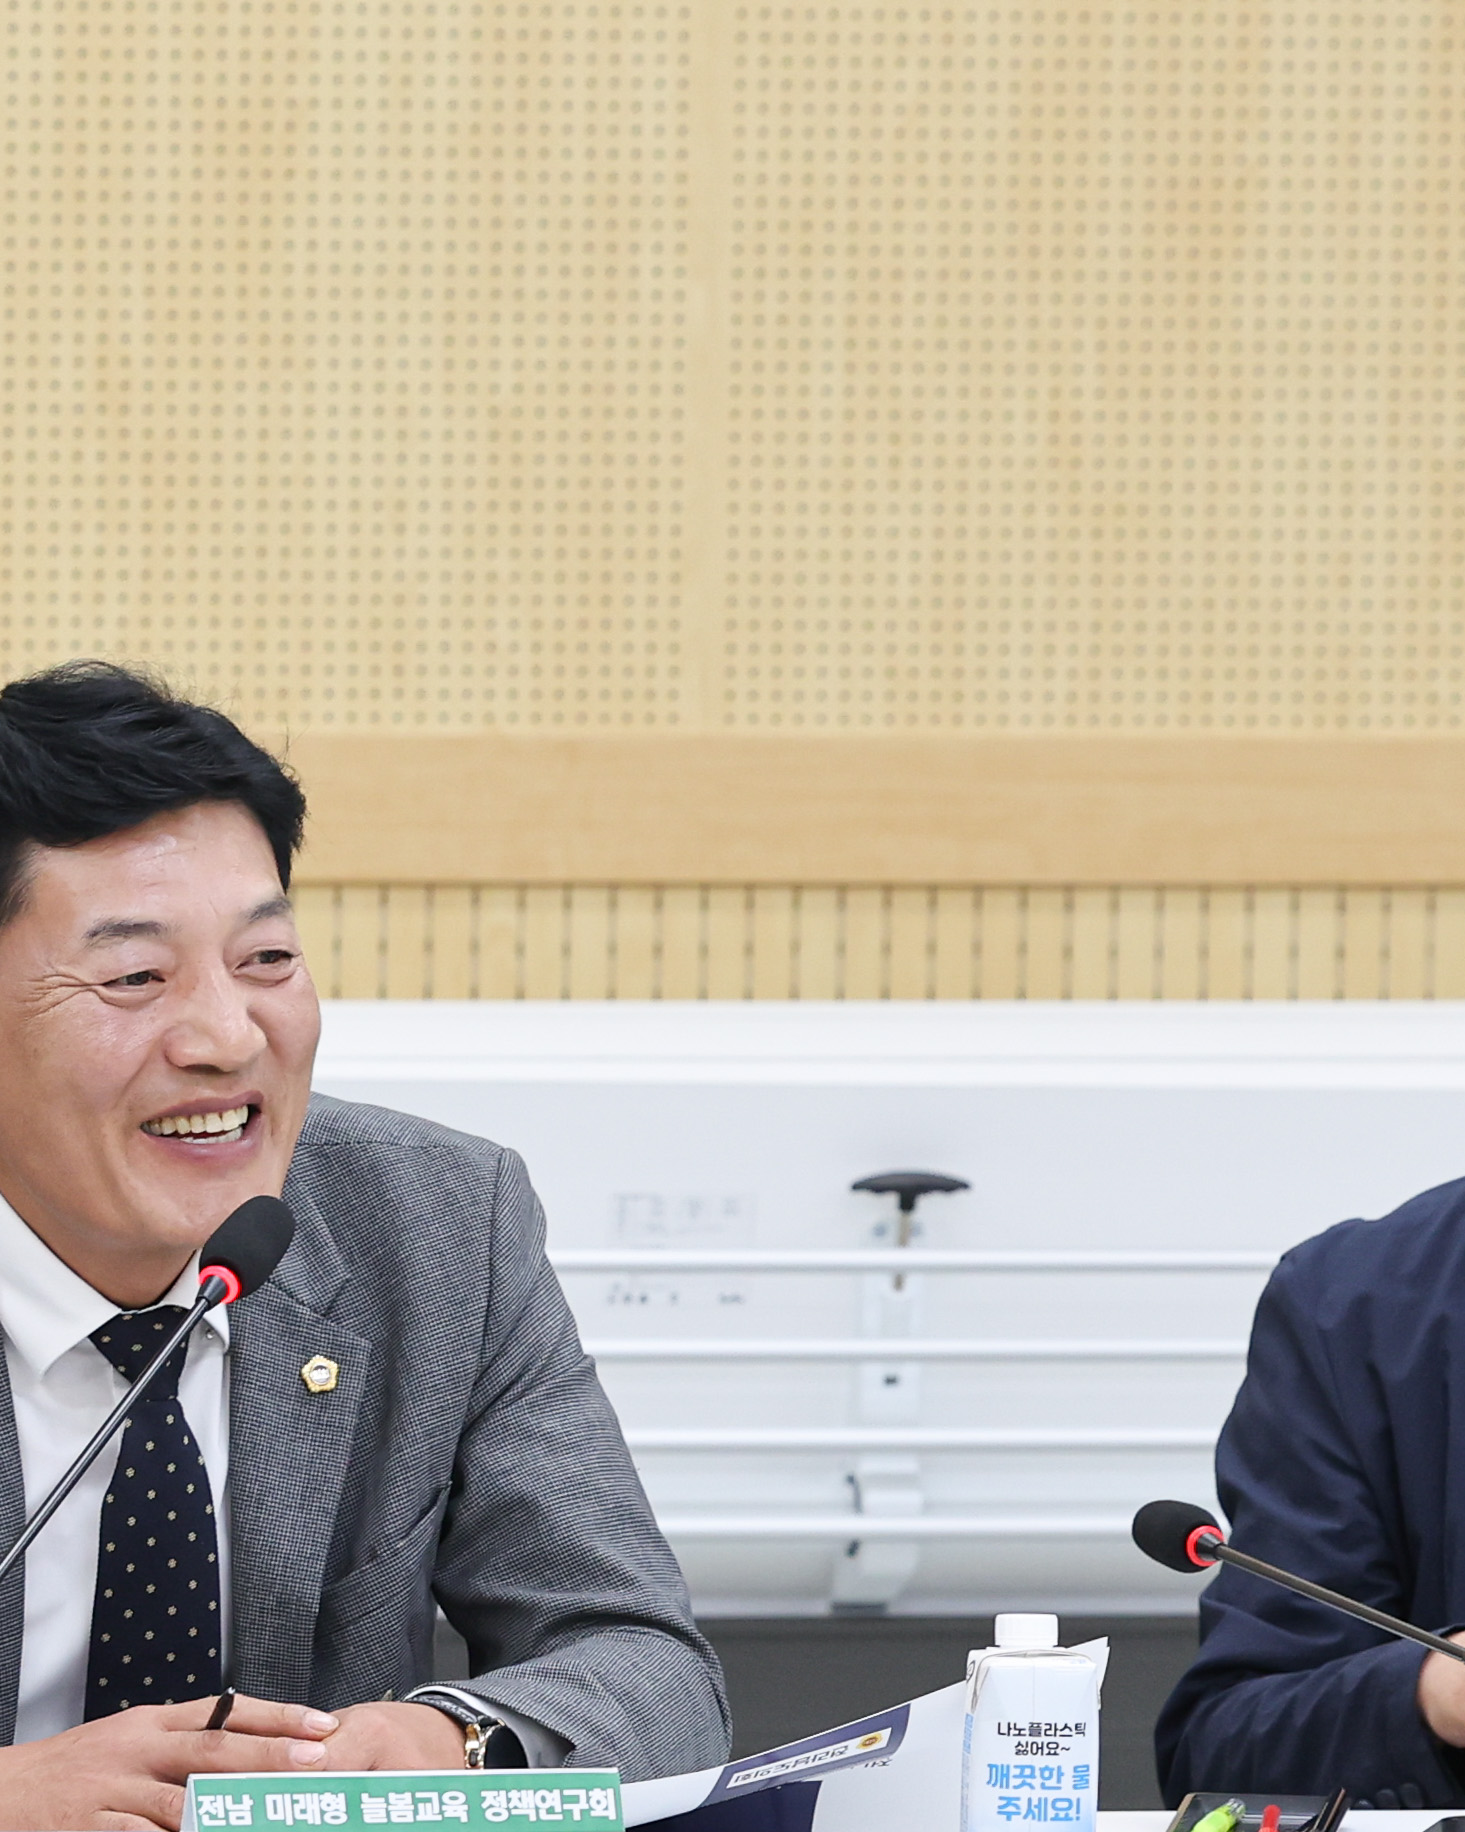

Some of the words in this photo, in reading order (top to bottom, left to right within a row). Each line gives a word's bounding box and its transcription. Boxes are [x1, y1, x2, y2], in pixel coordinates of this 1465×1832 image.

[997, 1721, 1087, 1738] 나노플라스틱
[986, 1763, 1065, 1791] 깨끗한
[1072, 1763, 1091, 1790] 물
[197, 1792, 253, 1827] 전남
[265, 1791, 347, 1826] 미래형
[360, 1790, 469, 1825] 늘봄교육
[480, 1788, 617, 1822] 정책연구회
[996, 1796, 1081, 1822] 주세요!
